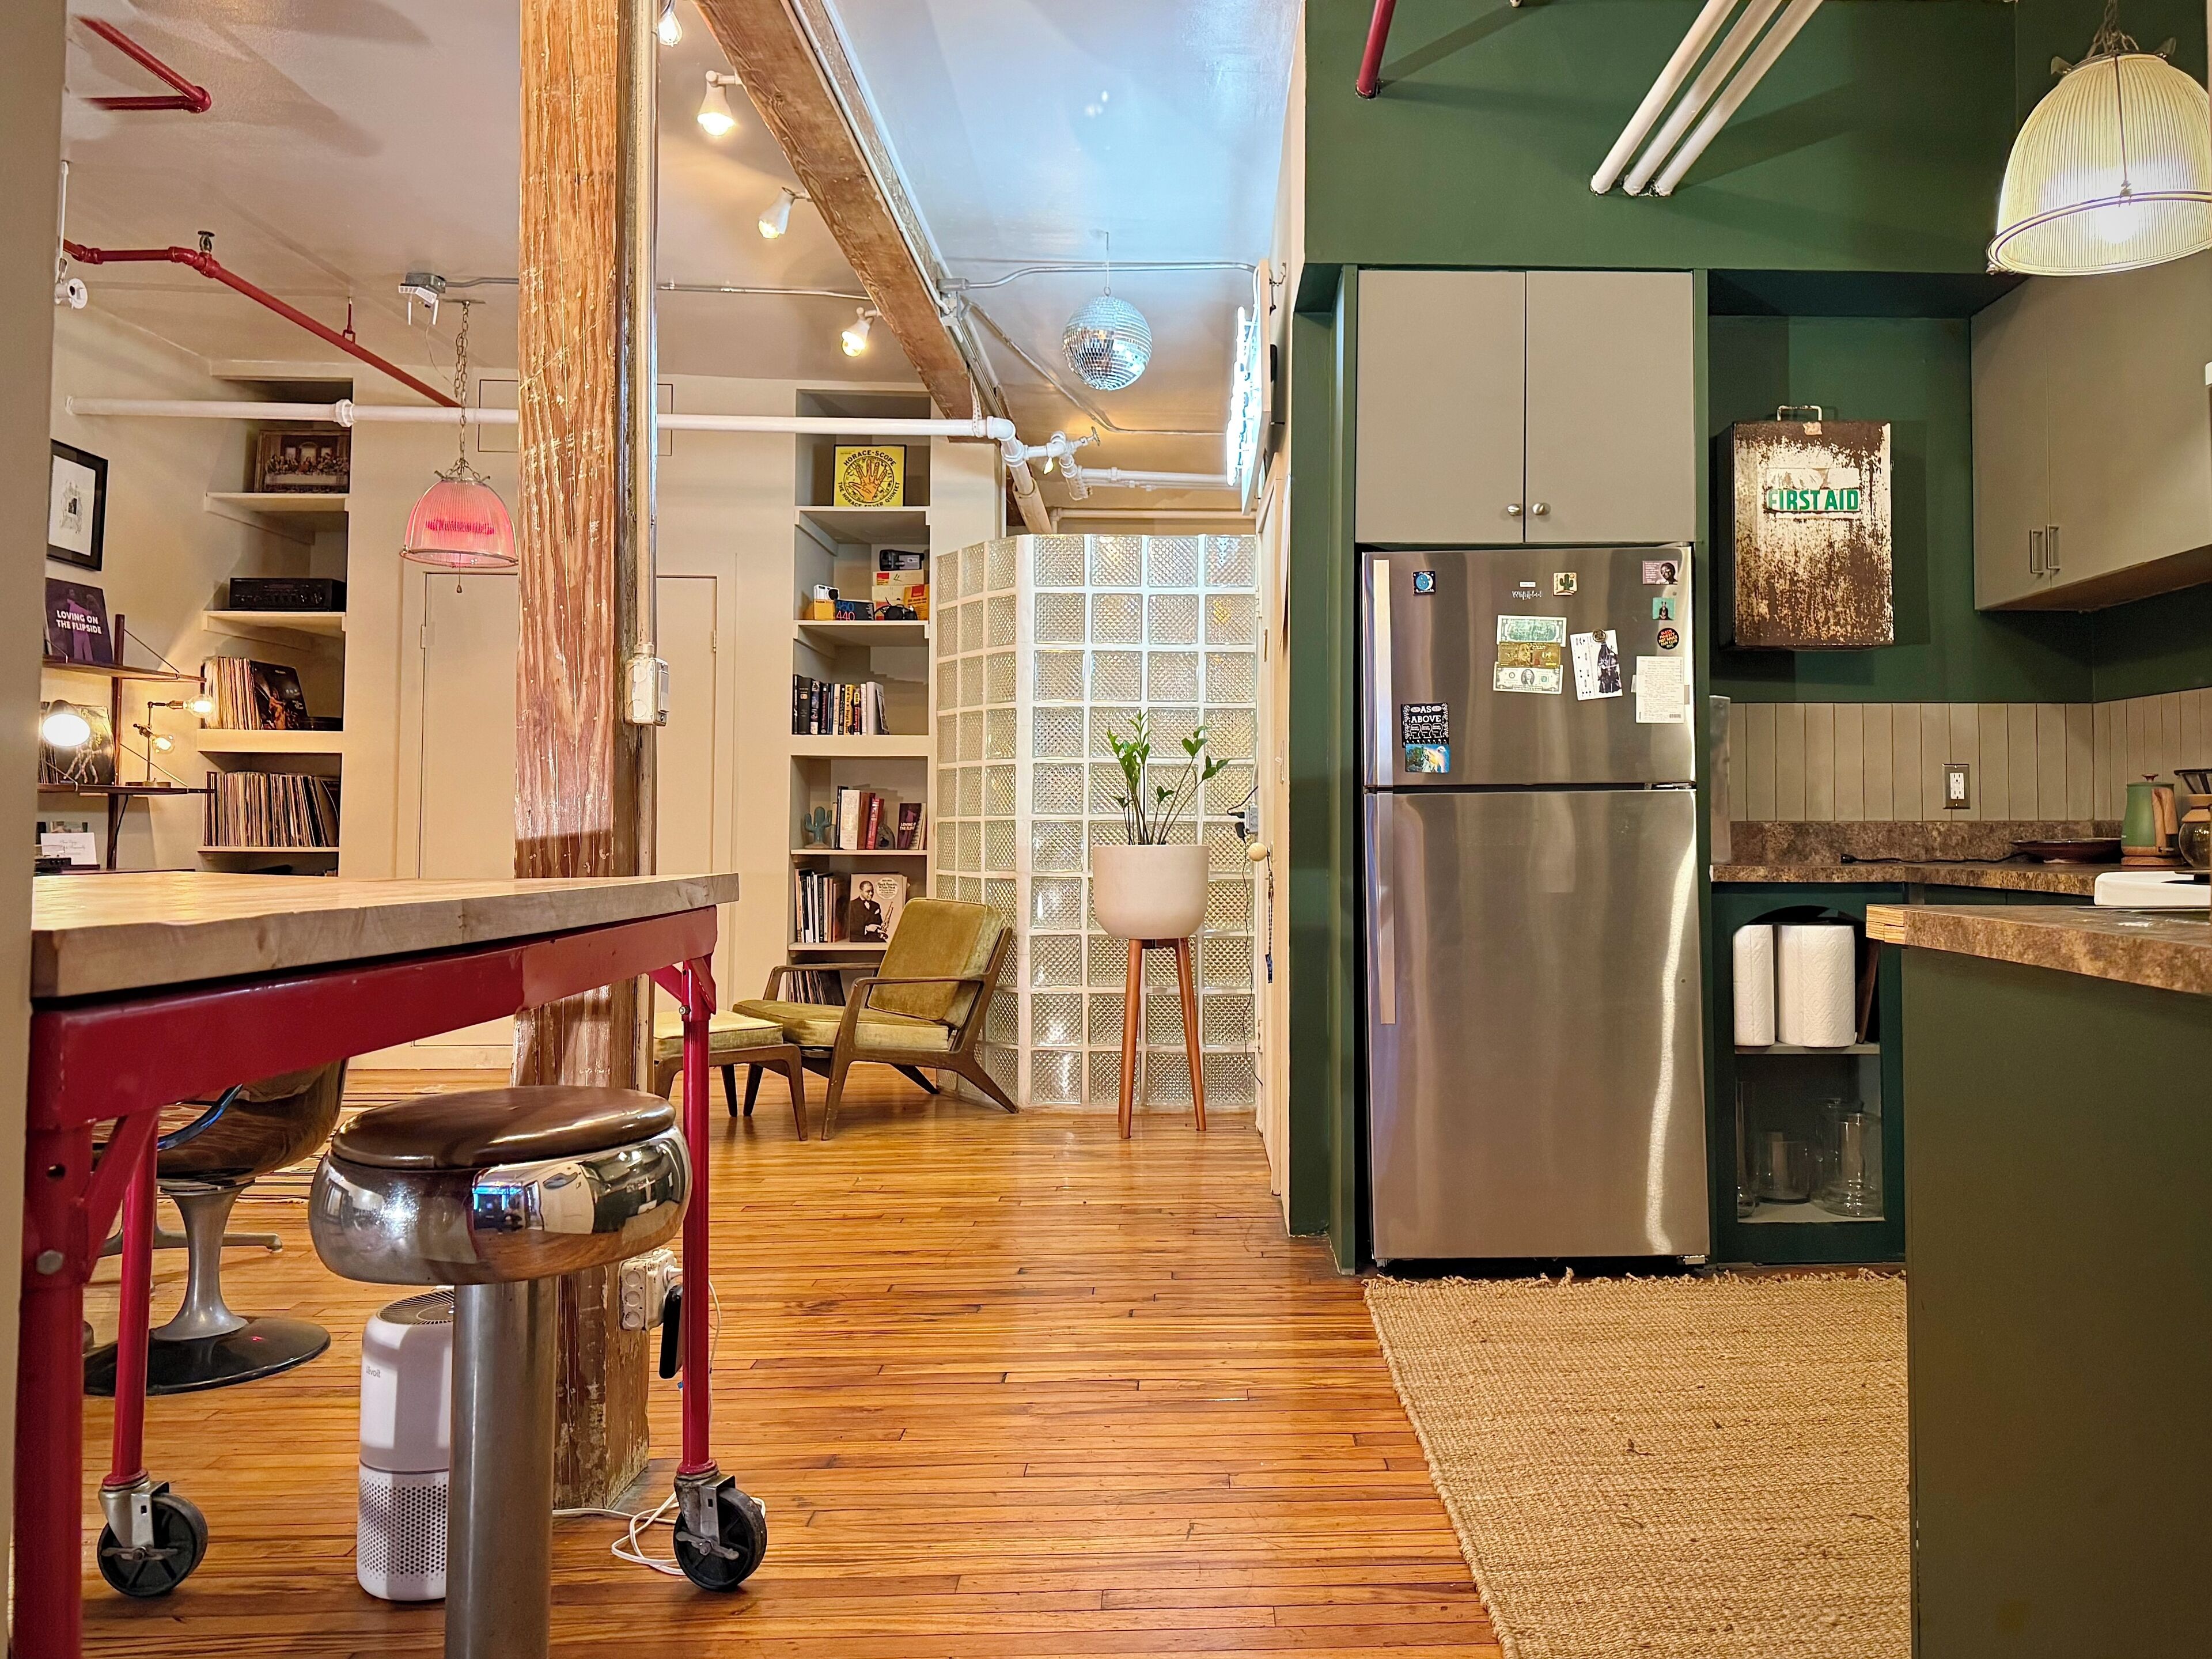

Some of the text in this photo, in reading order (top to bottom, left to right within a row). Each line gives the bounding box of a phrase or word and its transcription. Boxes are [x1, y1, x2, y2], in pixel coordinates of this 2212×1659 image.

[843, 450, 896, 467] HORACE-SCOPE
[842, 493, 862, 507] HORACE
[885, 482, 900, 503] QUINTET
[1768, 490, 1858, 510] FIRST AID
[836, 601, 855, 611] 450
[56, 609, 99, 624] LOVING ON
[836, 611, 855, 620] 440
[56, 619, 102, 634] THE FLIPSIDE
[1420, 706, 1432, 714] AS
[1411, 715, 1441, 724] ABOVE
